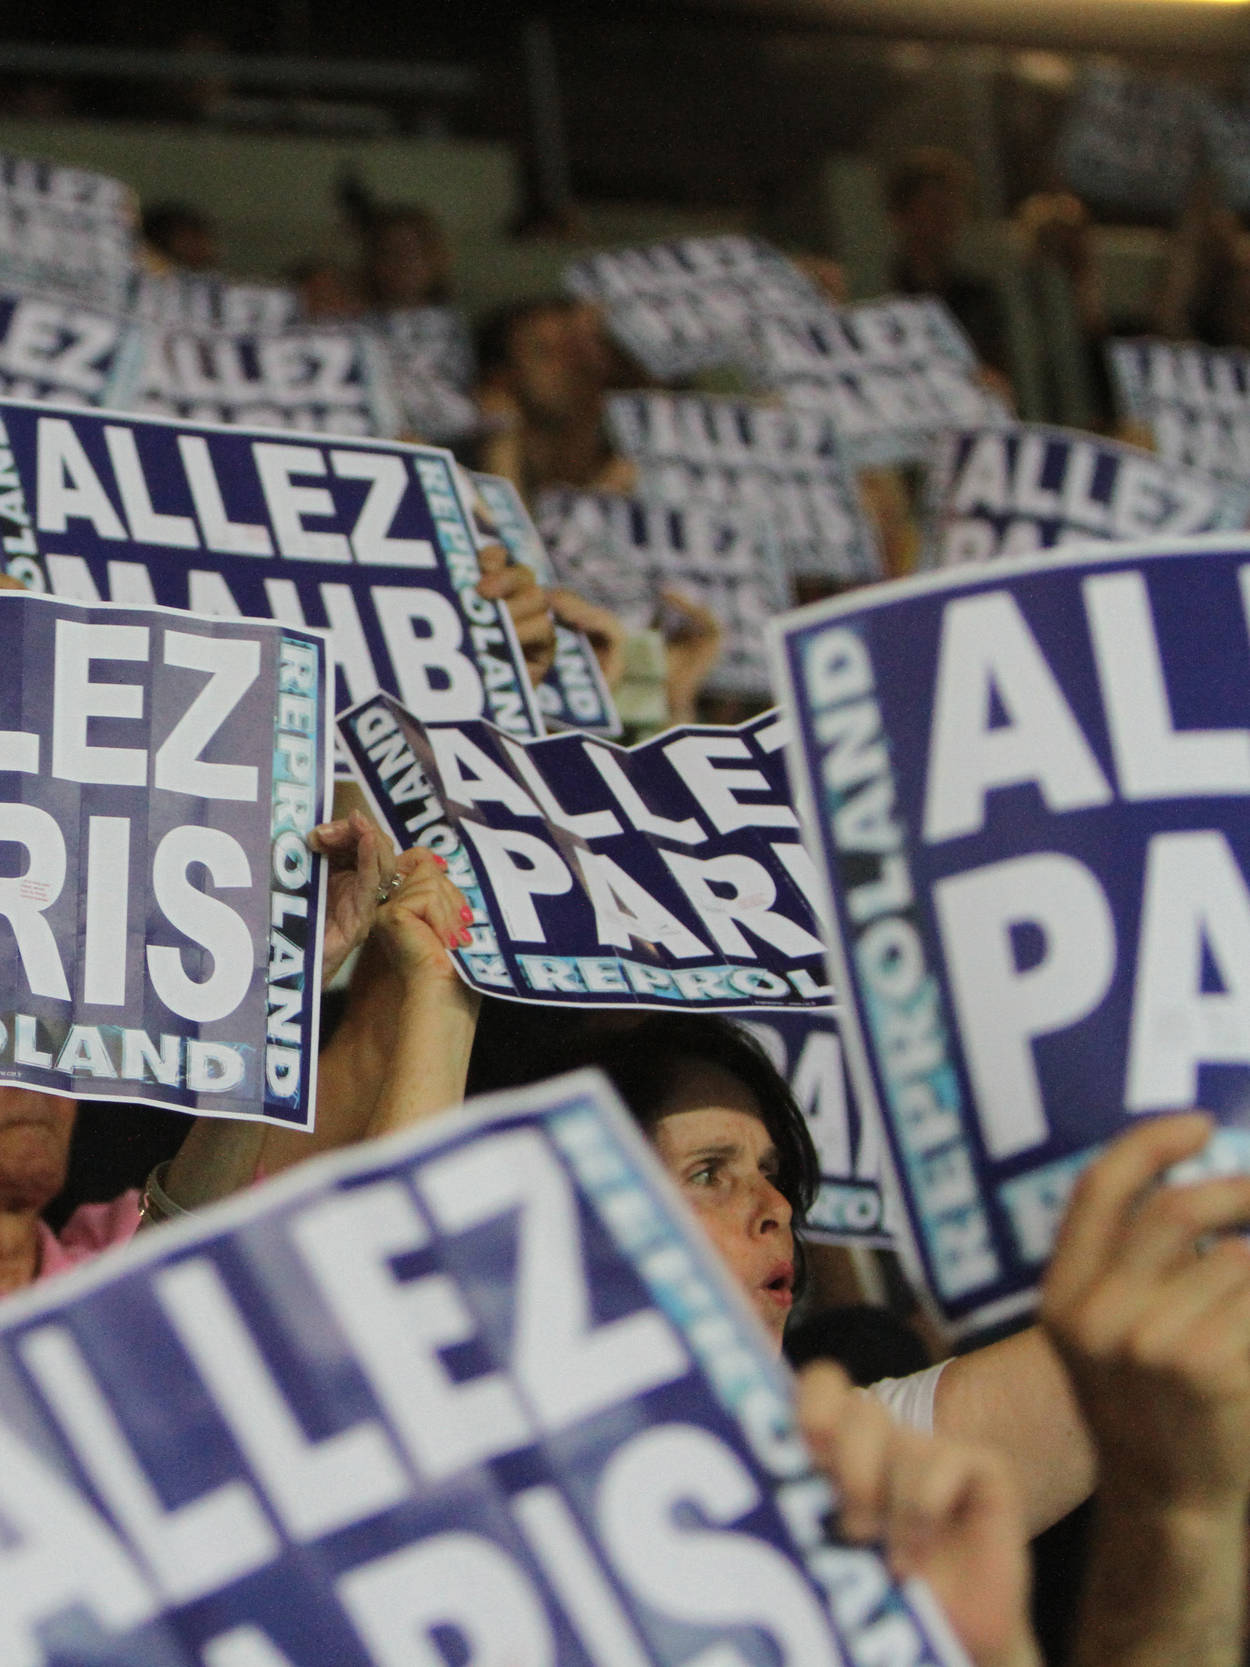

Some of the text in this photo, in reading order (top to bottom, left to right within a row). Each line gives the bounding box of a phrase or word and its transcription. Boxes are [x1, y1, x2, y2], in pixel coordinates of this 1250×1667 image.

[37, 417, 438, 568] ALLEZ
[416, 460, 538, 737] REPROLAN
[266, 638, 320, 1100] REPROLAND
[460, 818, 830, 959] PARI
[521, 955, 836, 1001] REPROL
